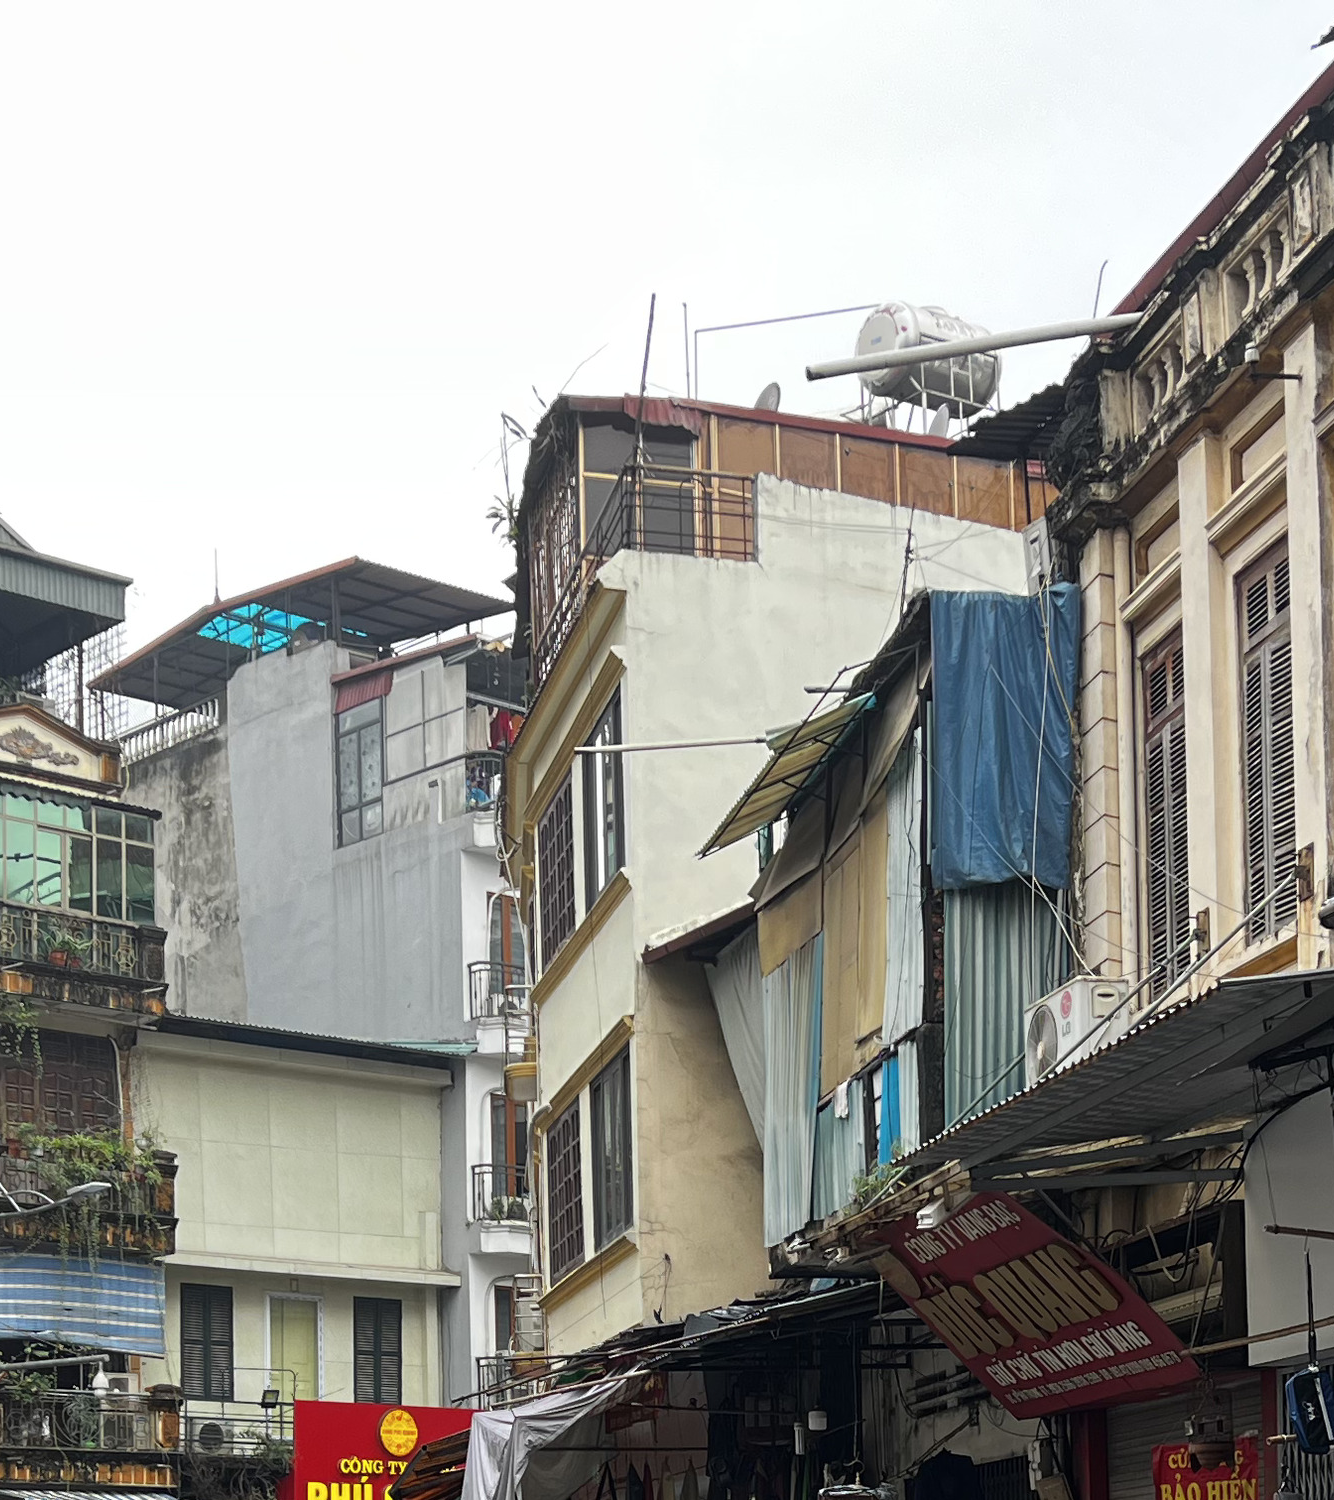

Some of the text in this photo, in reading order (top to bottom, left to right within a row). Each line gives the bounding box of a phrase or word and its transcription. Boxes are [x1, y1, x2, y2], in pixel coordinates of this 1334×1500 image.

[904, 1199, 1021, 1264] CÔNG TY BẠC
[973, 1244, 1118, 1342] QUANG
[340, 1456, 408, 1475] CÔNG TY
